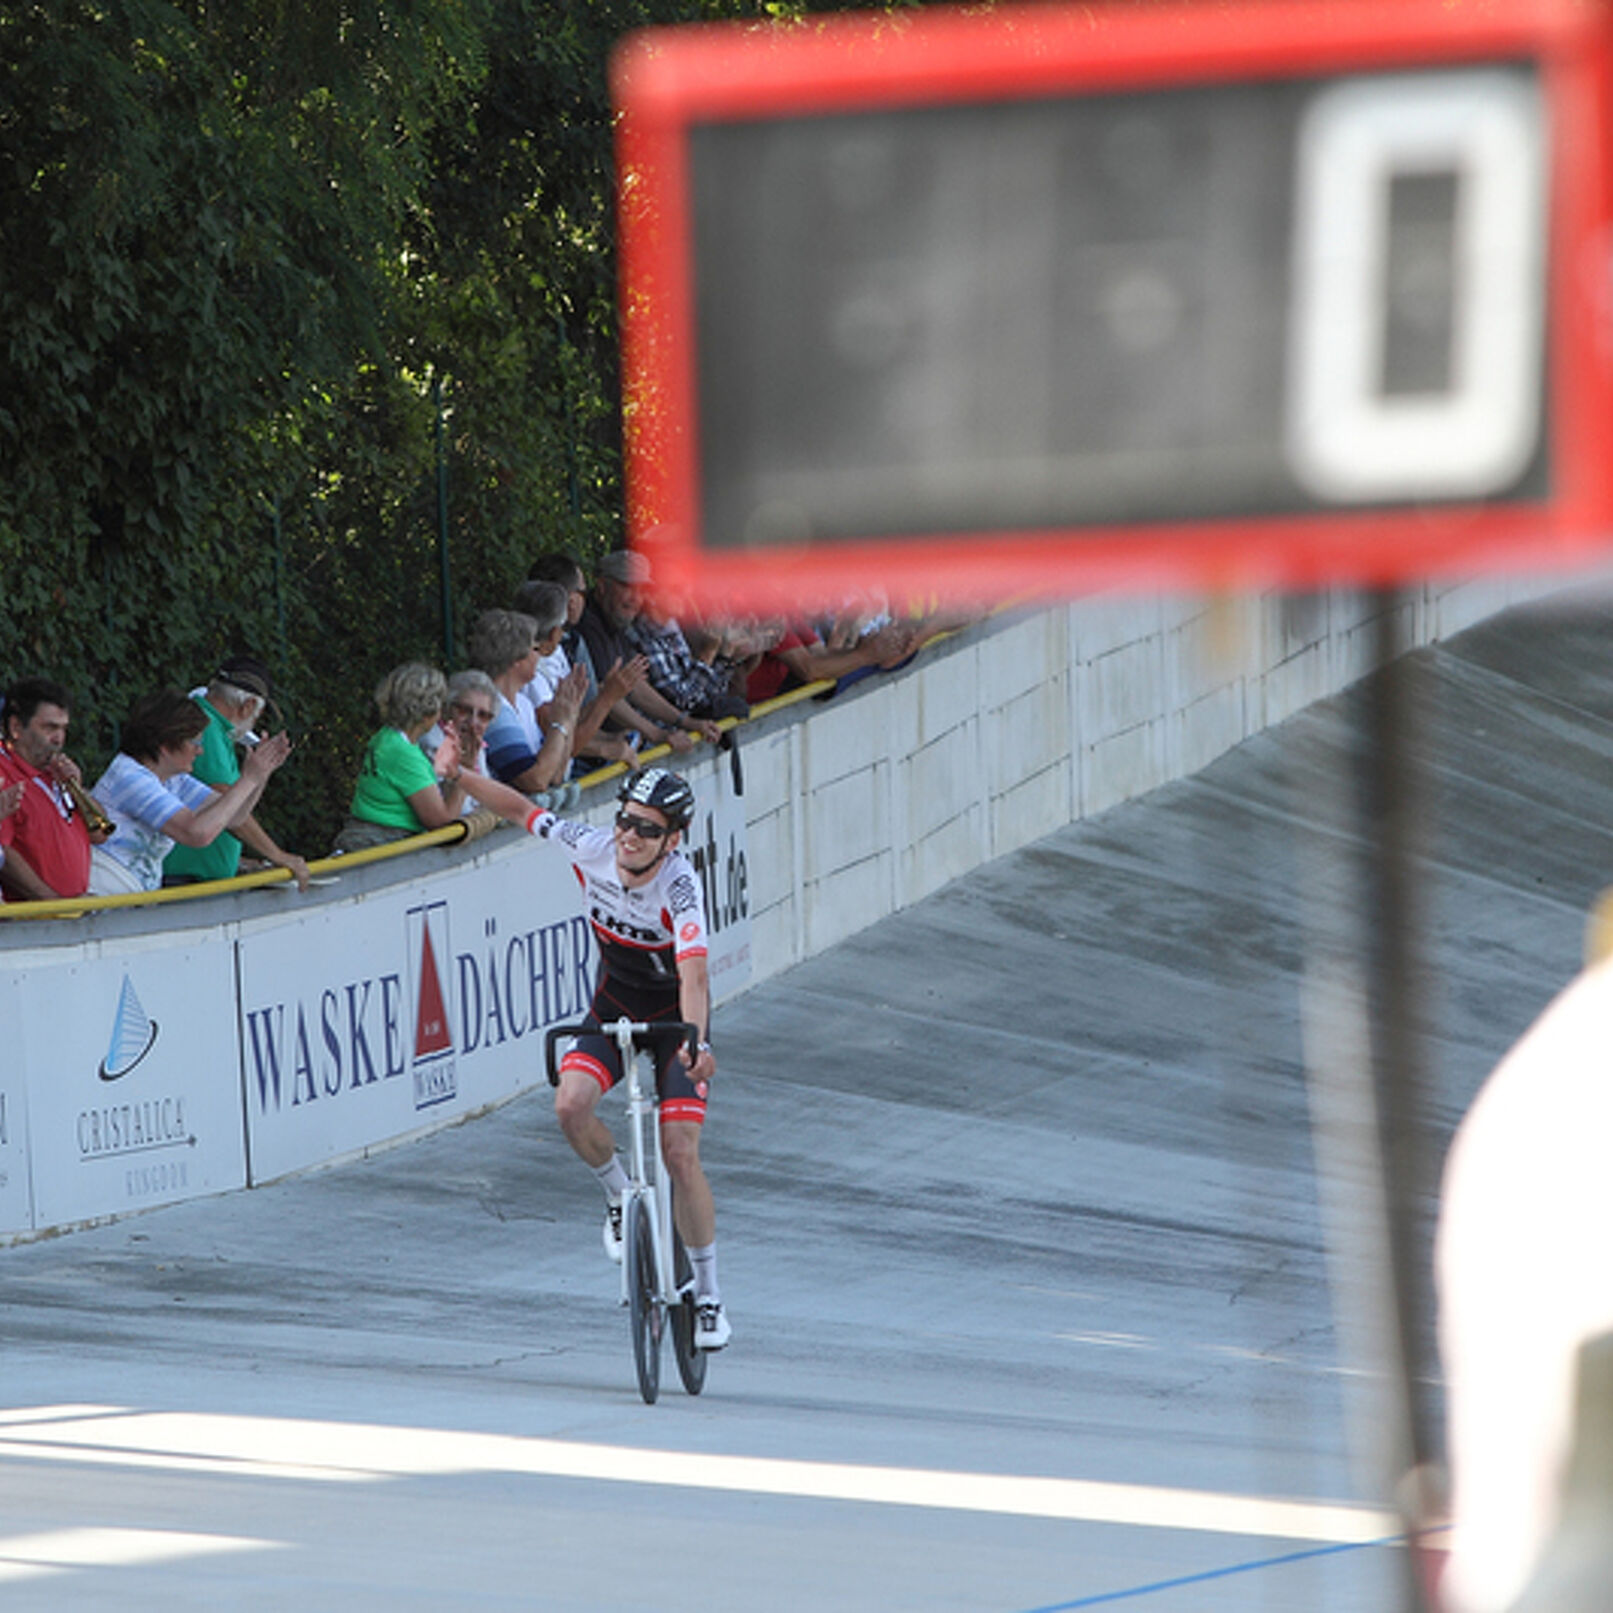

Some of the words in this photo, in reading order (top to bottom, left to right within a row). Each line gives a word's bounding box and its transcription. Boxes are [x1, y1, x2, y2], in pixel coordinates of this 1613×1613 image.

[246, 974, 405, 1114] WASKE
[456, 915, 594, 1054] DÄCHER
[77, 1097, 187, 1154] CRISTALICA
